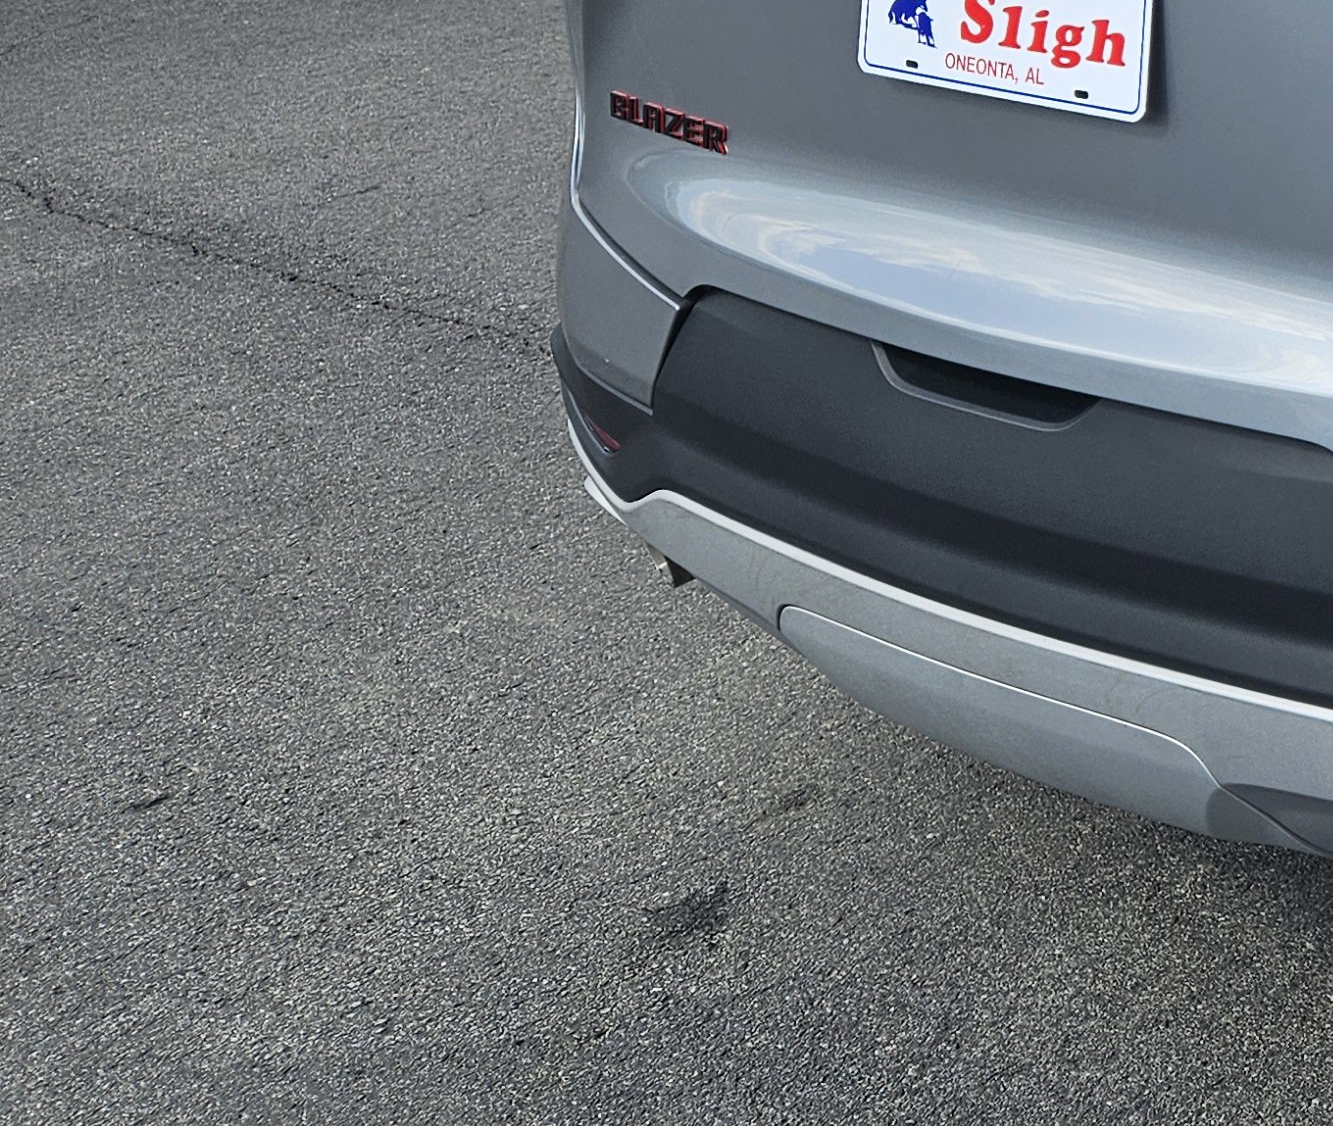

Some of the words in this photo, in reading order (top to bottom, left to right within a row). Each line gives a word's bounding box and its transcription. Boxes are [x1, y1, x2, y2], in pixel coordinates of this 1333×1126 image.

[945, 52, 1019, 85] ONEONTA,
[1025, 68, 1044, 85] AL
[610, 90, 729, 155] BLAZER
